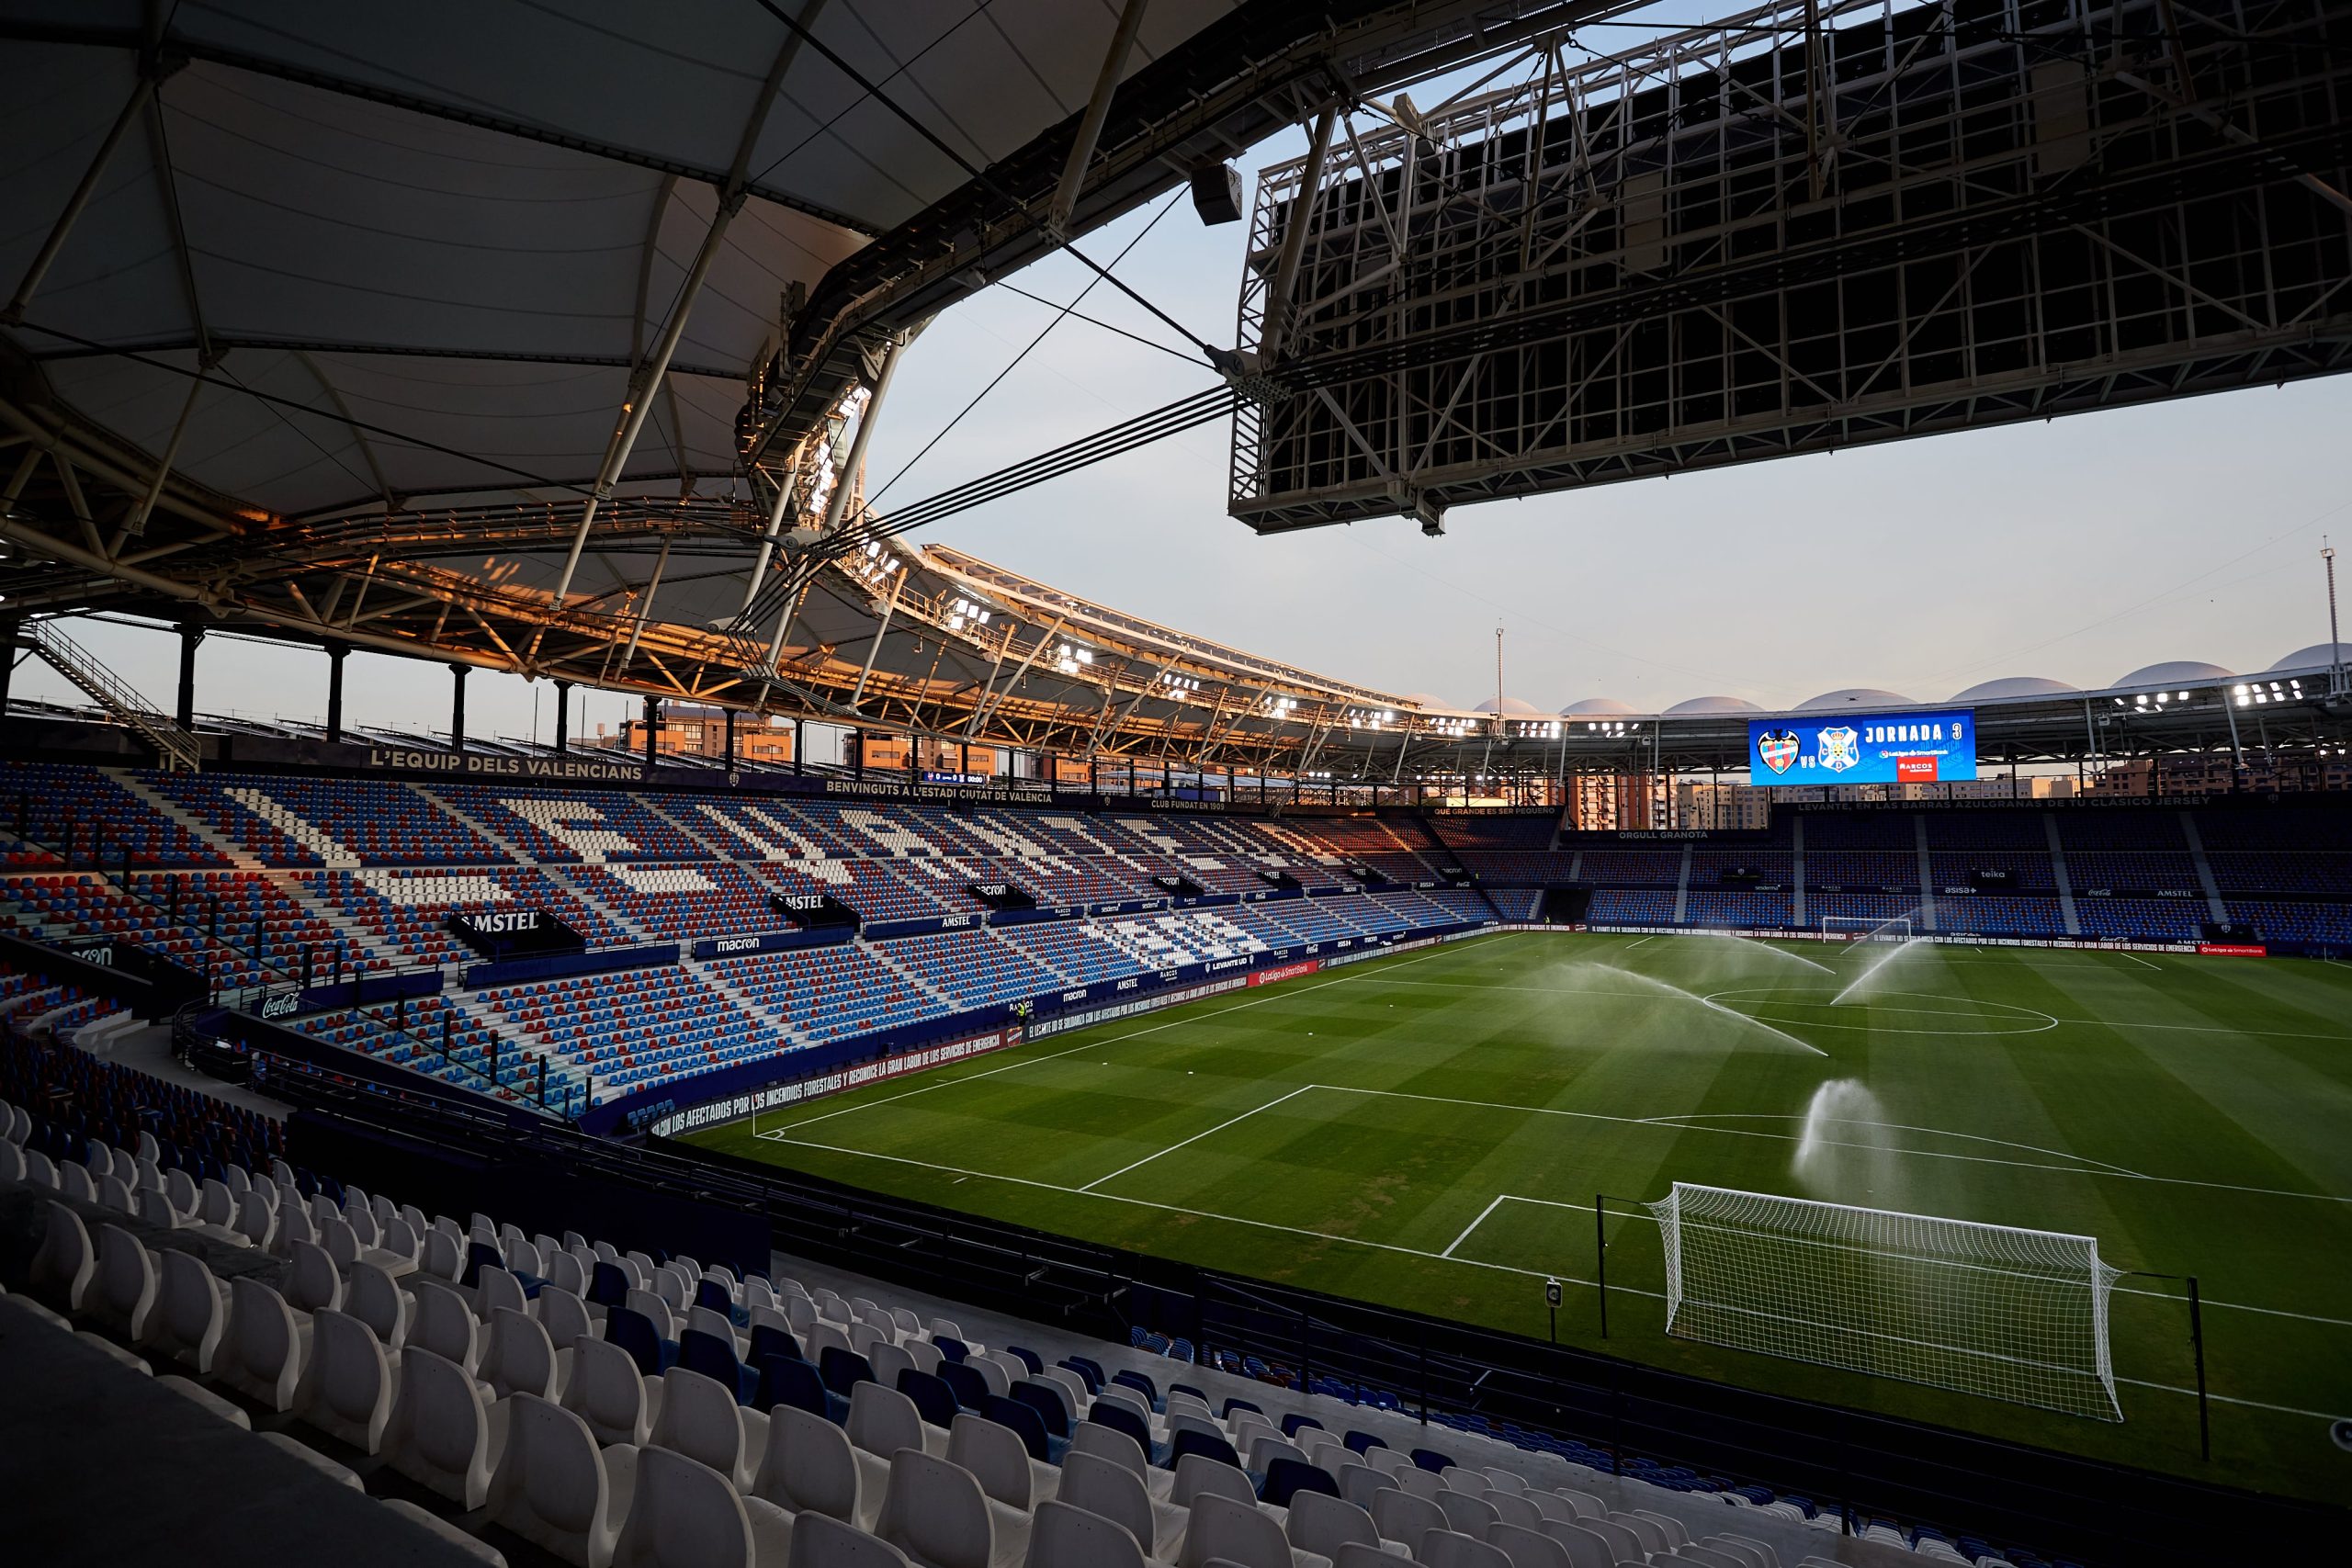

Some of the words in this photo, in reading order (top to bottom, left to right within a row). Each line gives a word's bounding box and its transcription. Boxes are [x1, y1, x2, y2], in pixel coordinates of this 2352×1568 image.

[1865, 724, 1942, 743] JORNADA
[1951, 722, 1962, 740] 3
[468, 756, 520, 773] DELS
[526, 760, 642, 780] VALENCIANS
[1800, 756, 1815, 768] VS
[826, 781, 899, 795] BENVINGUTS
[902, 787, 910, 796] A
[959, 789, 991, 800] CIUTAT
[994, 792, 1007, 801] DE
[1151, 800, 1170, 808] CLUB
[1171, 801, 1198, 809] FUNDAT
[1199, 801, 1209, 809] EN
[1210, 802, 1225, 811] 1909
[1857, 802, 1872, 810] EN
[1875, 801, 1898, 810] LAS
[1902, 800, 1951, 809] BARRAS
[1956, 799, 2042, 808] AZULGRANAS
[2047, 799, 2064, 807] DE
[2155, 796, 2211, 806] JERSEY
[1452, 807, 1487, 816] GRANDE
[1487, 807, 1497, 816] ES
[1498, 807, 1514, 816] SER
[1660, 830, 1708, 839] GRANOTA
[942, 917, 970, 929] AMSTEL
[717, 938, 760, 953] macron
[1213, 959, 1237, 970] LEVANTE
[1265, 971, 1281, 980] LaLiga
[1285, 964, 1307, 976] SmartBank
[1117, 978, 1137, 990] AMSTEL
[1063, 989, 1087, 1002] macron
[1029, 1026, 1034, 1038] EL
[673, 1111, 685, 1132] LOS
[686, 1100, 731, 1127] AFECTADOS
[733, 1096, 750, 1115] POR
[767, 1084, 803, 1106] INCENDIOS
[804, 1075, 842, 1098] FORESTALES
[842, 1073, 848, 1087] Y
[849, 1065, 877, 1086] RECONOCE
[878, 1061, 887, 1077] LA
[888, 1057, 904, 1074] GRAN
[904, 1054, 922, 1069] LABOR
[922, 1053, 929, 1065] DE
[930, 1050, 940, 1064] LOS
[941, 1043, 965, 1060] SERVICIOS
[966, 1043, 973, 1054] DE
[973, 1034, 1000, 1052] EMERGENCIA
